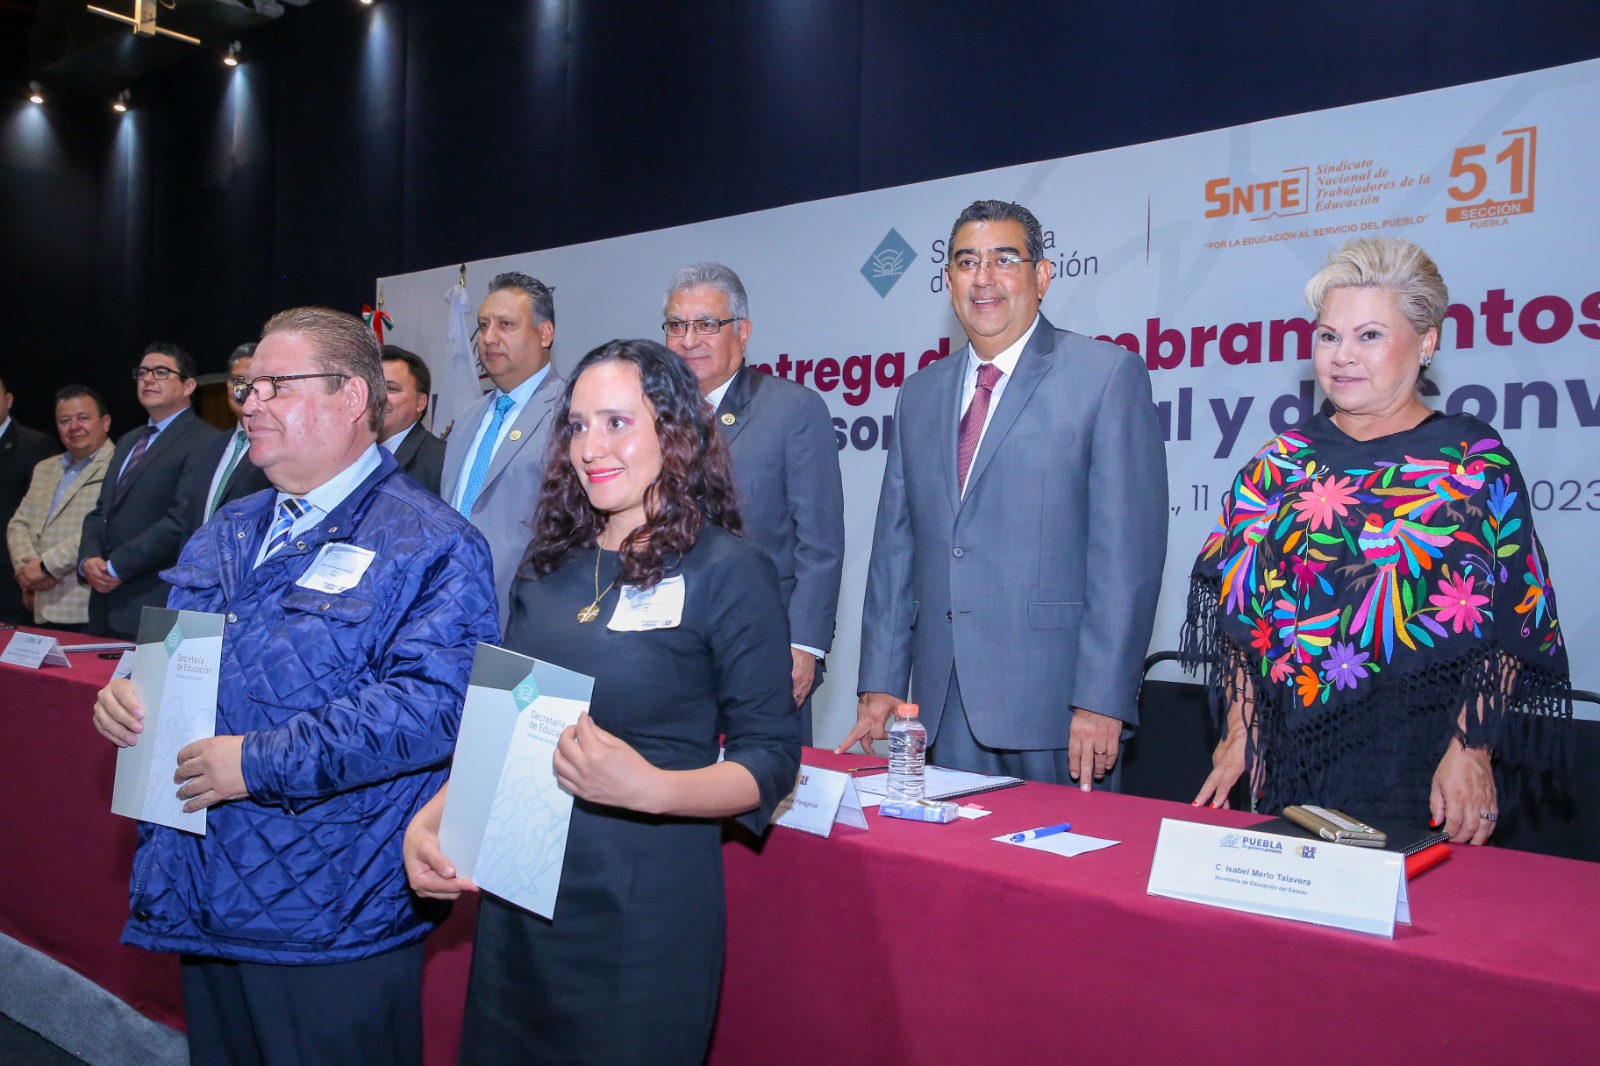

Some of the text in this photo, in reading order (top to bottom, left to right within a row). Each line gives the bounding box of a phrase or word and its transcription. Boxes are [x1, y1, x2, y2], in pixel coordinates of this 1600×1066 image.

[1315, 160, 1373, 175] Sindicato
[1315, 168, 1389, 186] Nacional de
[1447, 137, 1524, 202] 51
[1205, 177, 1300, 219] SNTE
[1316, 174, 1431, 199] Trabajadores de la
[1315, 195, 1380, 212] Educación
[1460, 203, 1520, 220] SECCIÓN
[1229, 240, 1240, 248] LA
[1298, 230, 1310, 239] AL
[1313, 224, 1358, 237] SERVICIO
[1360, 221, 1380, 231] DEL
[1470, 218, 1509, 229] PUEBLA
[931, 268, 949, 293] d
[743, 352, 905, 407] trega
[1208, 396, 1255, 459] y
[1192, 485, 1208, 511] 11
[1531, 480, 1600, 511] 023
[538, 723, 560, 737] Educa
[1242, 836, 1283, 850] PUEBLA
[1215, 863, 1312, 886] C. Isabel Merlo Talavera
